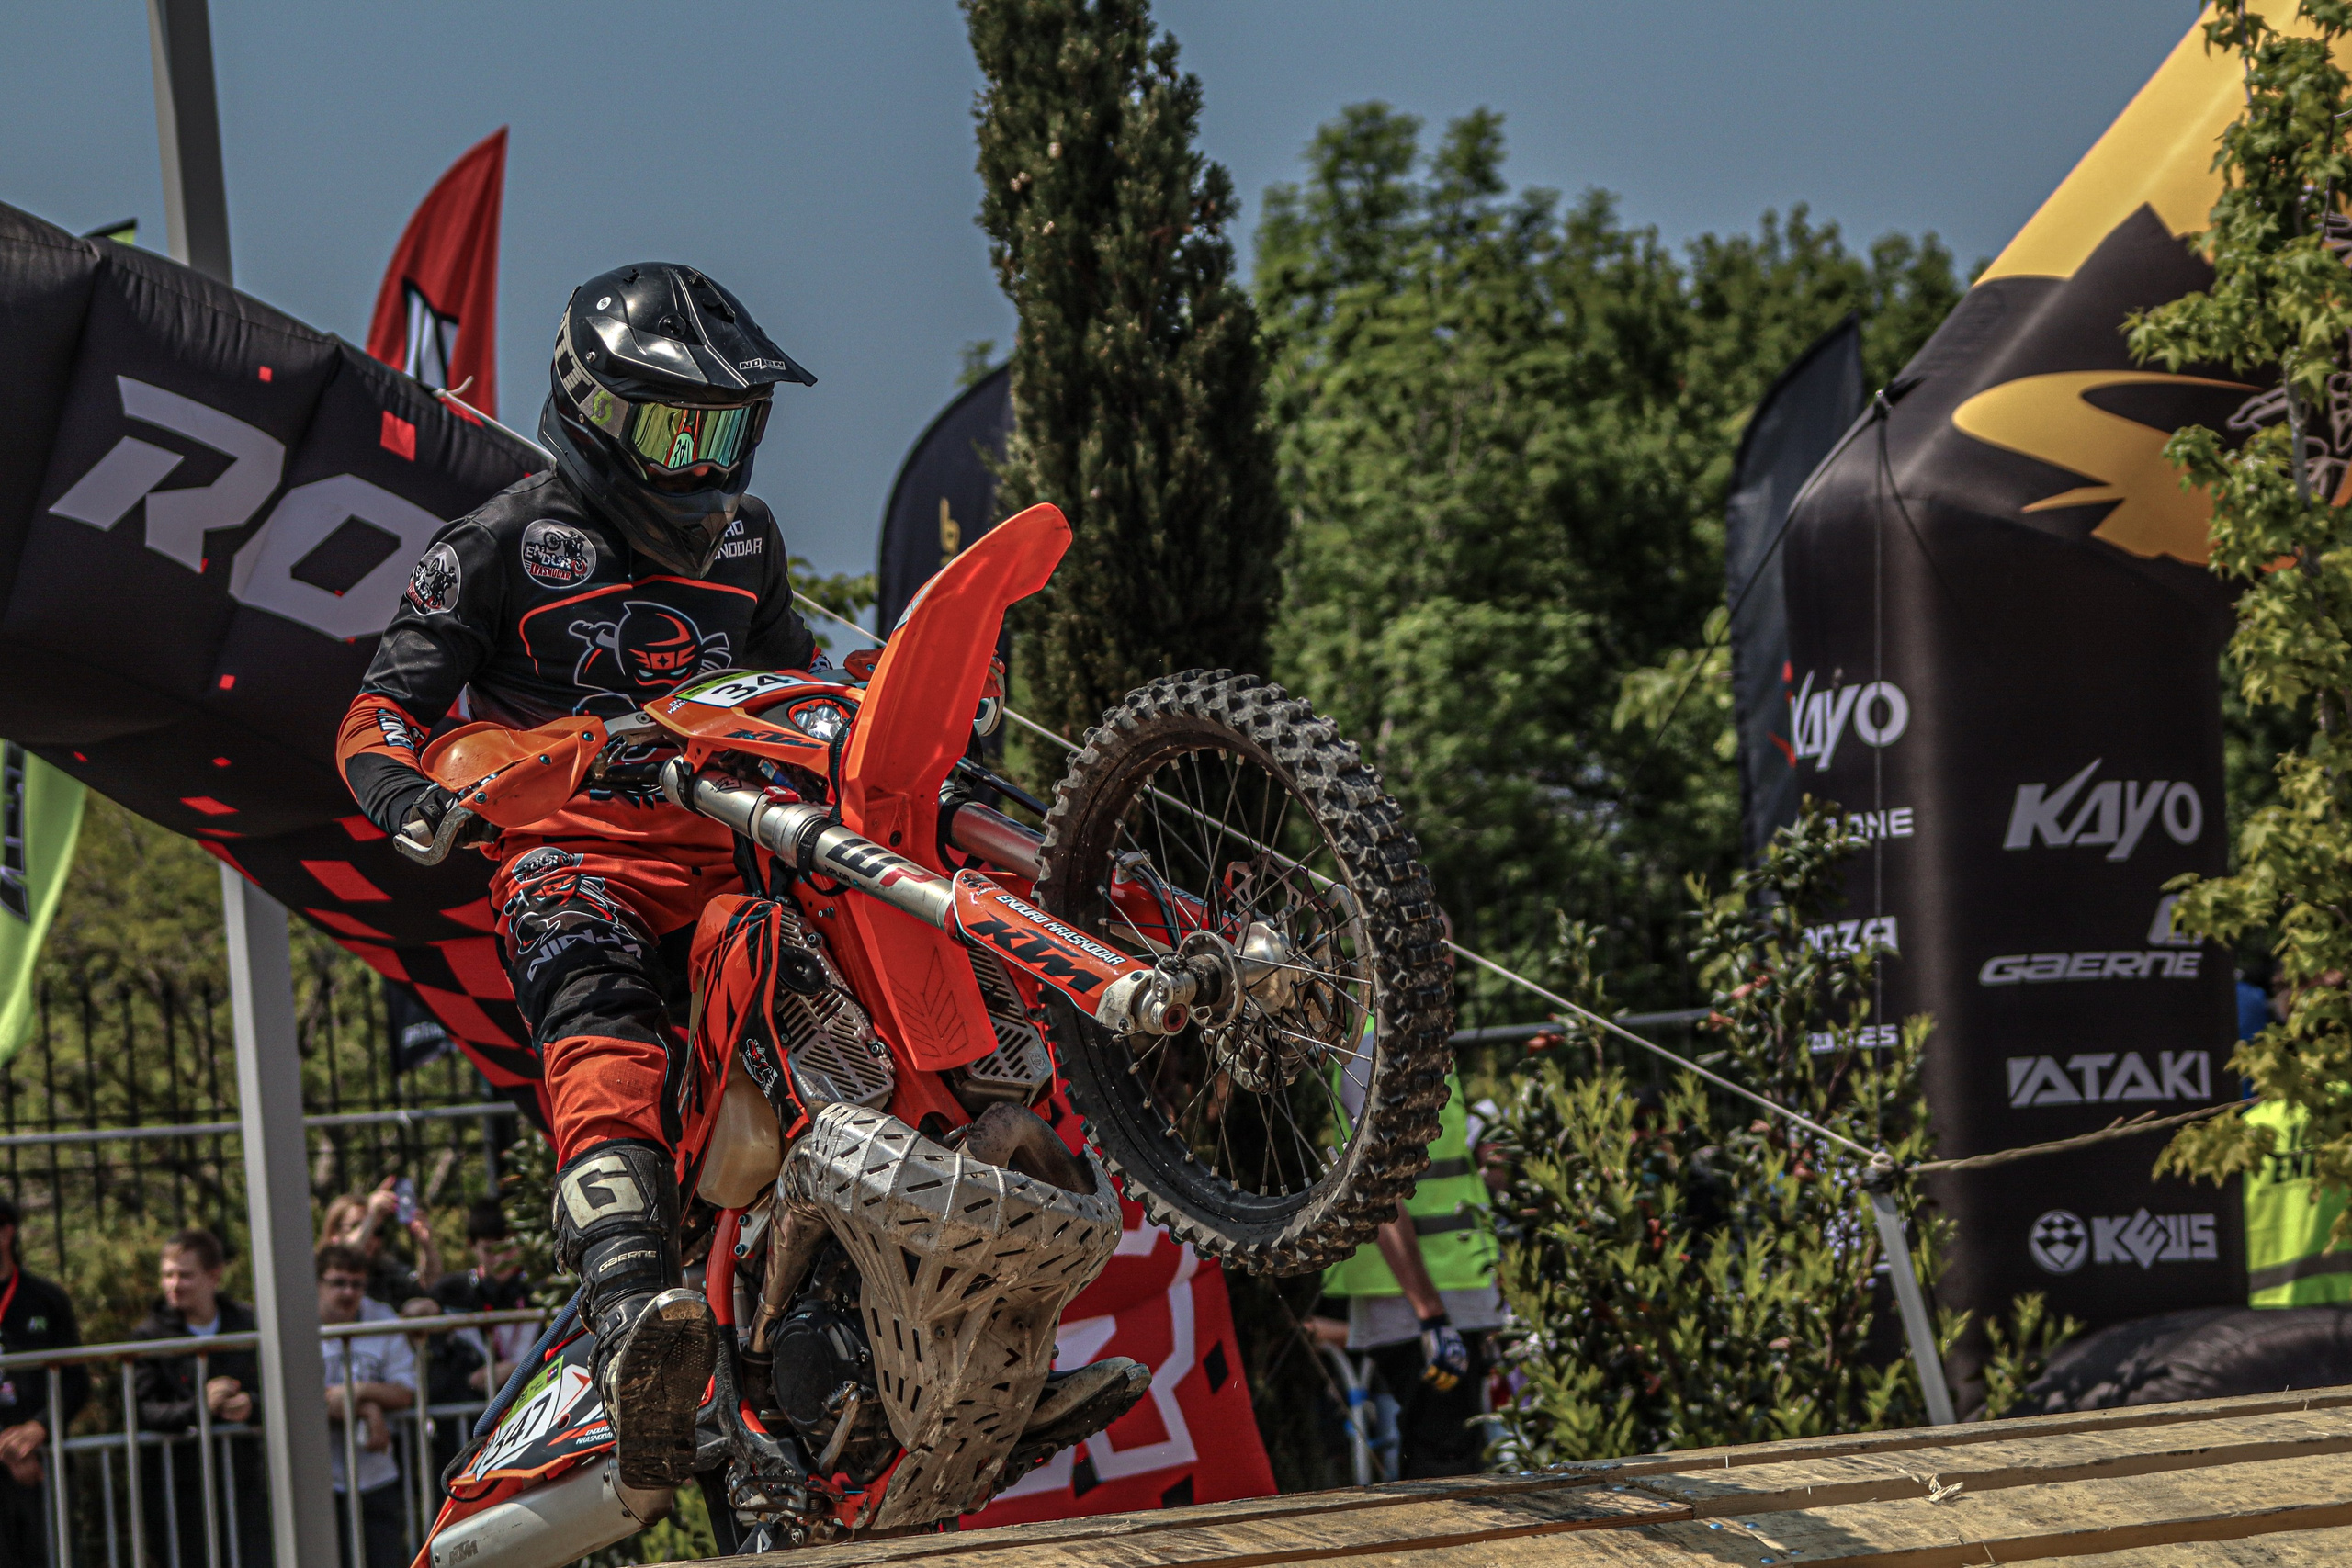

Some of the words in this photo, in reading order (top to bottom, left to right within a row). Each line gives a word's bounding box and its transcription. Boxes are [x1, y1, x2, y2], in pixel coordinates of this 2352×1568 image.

[740, 358, 786, 370] NOLAN
[723, 727, 825, 750] KTM
[2003, 757, 2204, 863] KAYO
[995, 894, 1054, 926] ENDURO
[1043, 919, 1127, 967] KRASNODAR
[967, 910, 1104, 994] KTM
[1978, 951, 2203, 987] GAERNE
[598, 1250, 657, 1274] GAERNE
